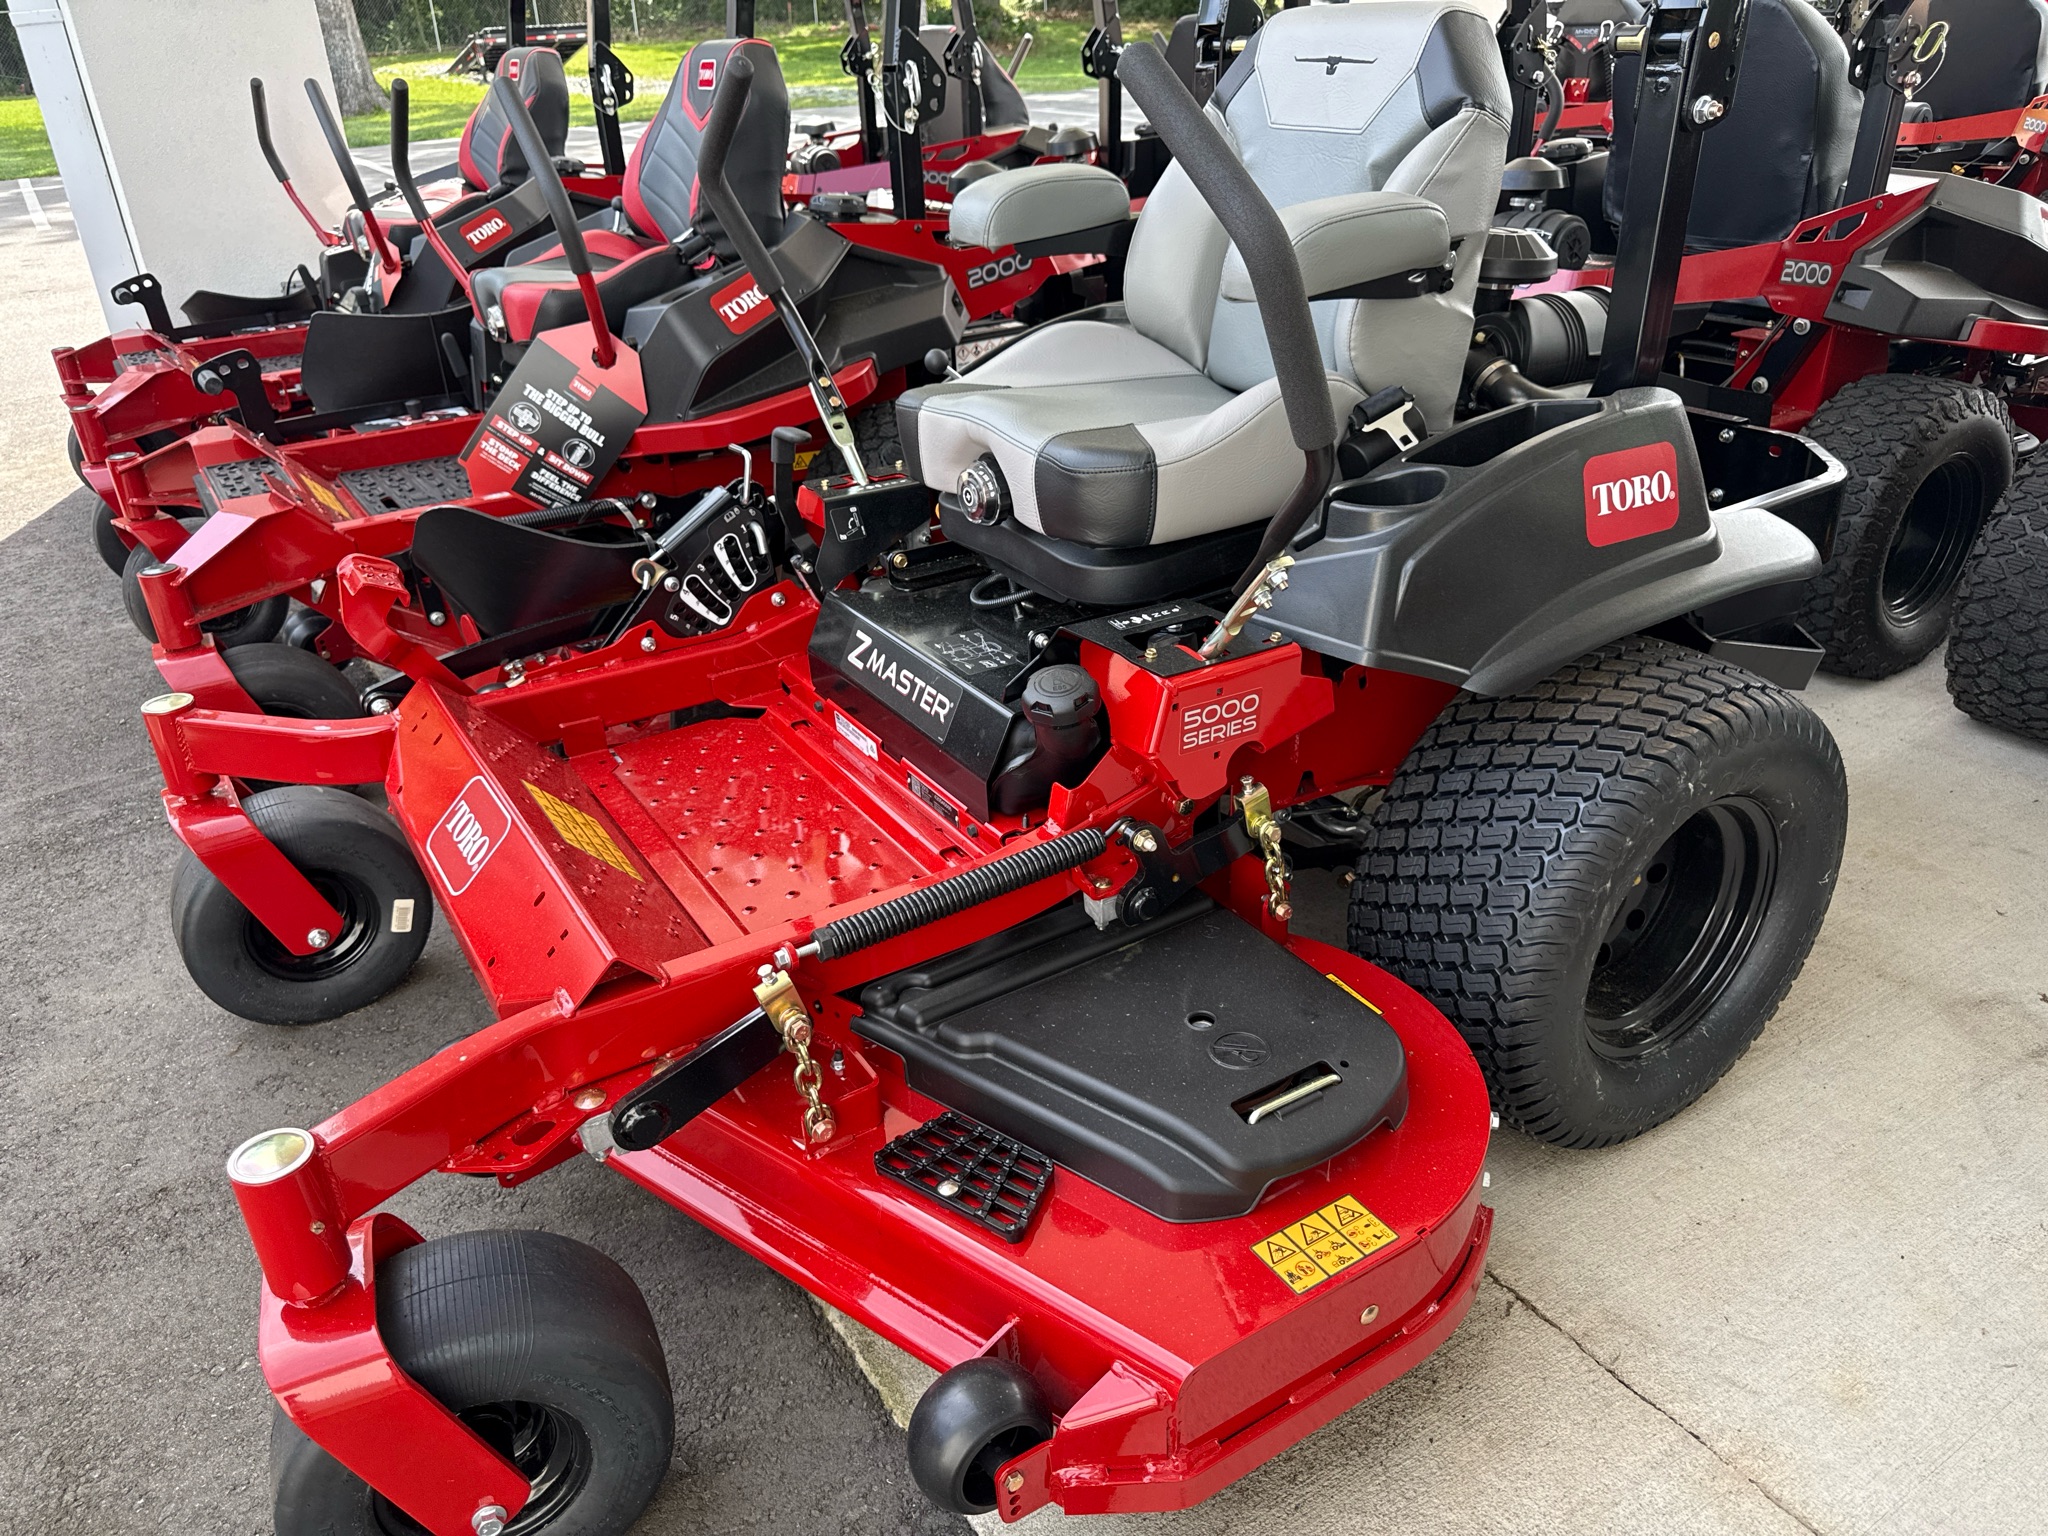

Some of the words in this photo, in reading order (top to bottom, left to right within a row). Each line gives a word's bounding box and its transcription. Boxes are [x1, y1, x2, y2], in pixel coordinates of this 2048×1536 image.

[2023, 117, 2046, 133] 2000
[1780, 260, 1832, 285] 2000
[523, 383, 545, 405] THE
[542, 398, 580, 430] BIGGER
[578, 423, 605, 447] BULL
[545, 388, 568, 407] STEP
[566, 403, 580, 415] UP
[580, 411, 593, 425] TO
[488, 437, 519, 459] STOMP
[496, 420, 520, 437] STEP
[518, 434, 533, 446] UP
[480, 440, 498, 457] THE
[497, 451, 521, 471] DECK
[548, 454, 564, 468] SIT
[562, 464, 590, 483] DOWN
[530, 471, 582, 502] DIFFERENCE
[539, 468, 560, 485] FEEL
[561, 480, 579, 494] THE
[1184, 693, 1259, 730] 5000
[1182, 714, 1257, 750] SERIES
